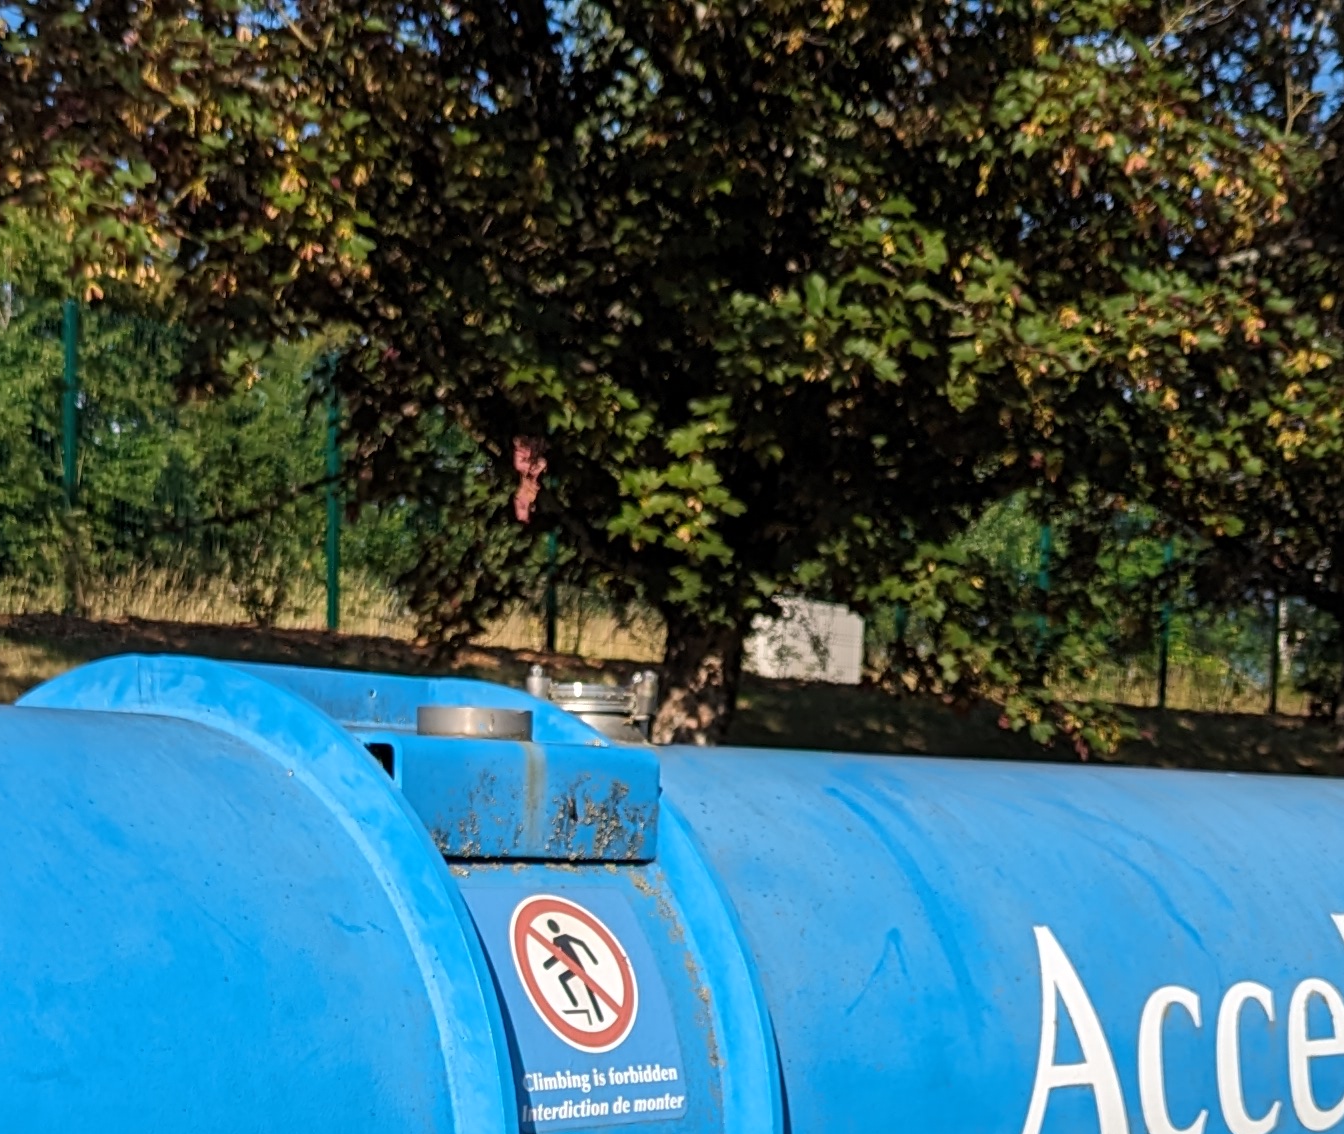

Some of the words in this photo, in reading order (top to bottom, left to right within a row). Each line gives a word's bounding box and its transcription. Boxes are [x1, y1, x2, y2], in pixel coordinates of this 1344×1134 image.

[523, 1071, 591, 1093] Climbing
[592, 1068, 606, 1087] is
[608, 1064, 678, 1086] forbidden
[522, 1099, 609, 1123] Interdiction
[613, 1096, 631, 1114] de
[633, 1093, 685, 1113] monter
